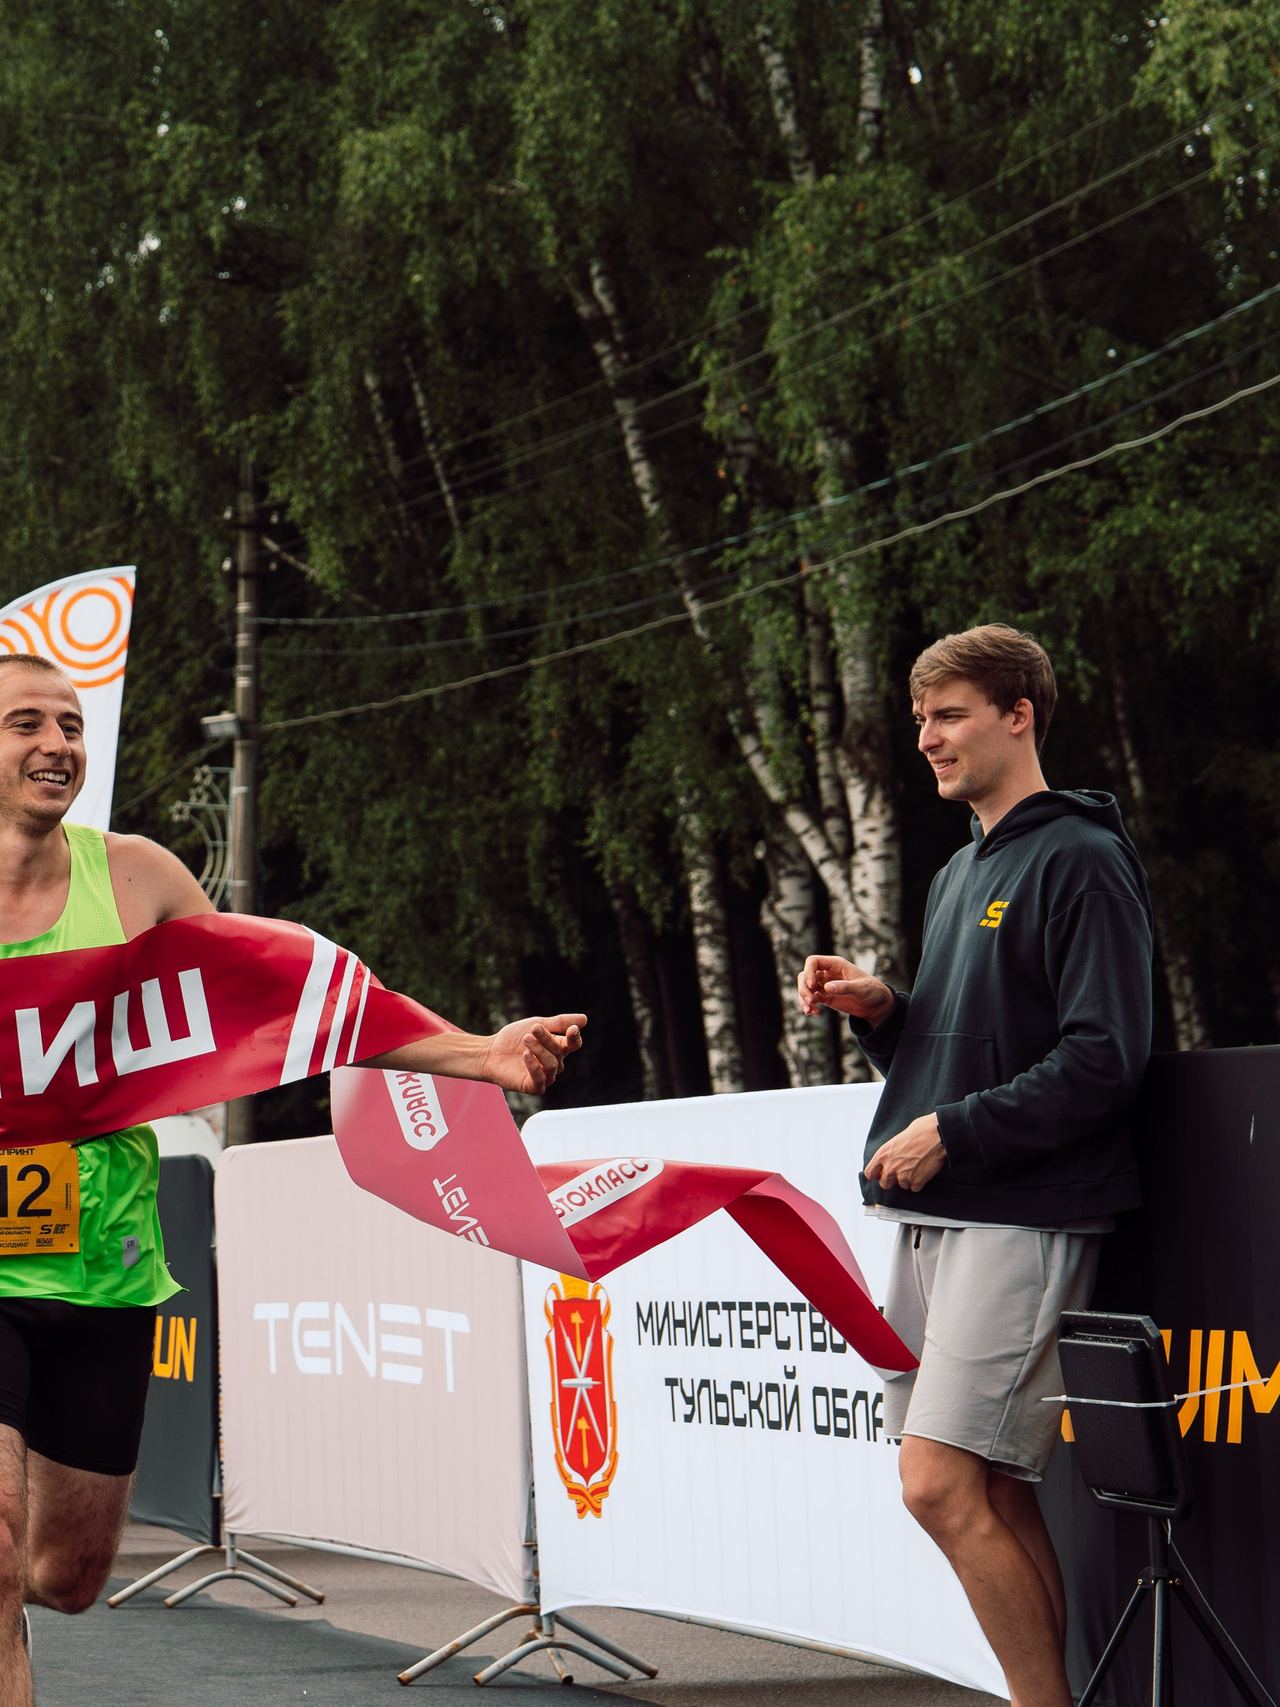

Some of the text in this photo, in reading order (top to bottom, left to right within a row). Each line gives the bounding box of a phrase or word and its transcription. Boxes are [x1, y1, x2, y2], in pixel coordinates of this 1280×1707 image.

[150, 1315, 198, 1383] UN
[253, 1301, 471, 1393] TENET
[635, 1300, 848, 1355] МИНИСТЕРСТВО
[664, 1364, 902, 1446] ТУЛЬСКОЙ ОБЛА
